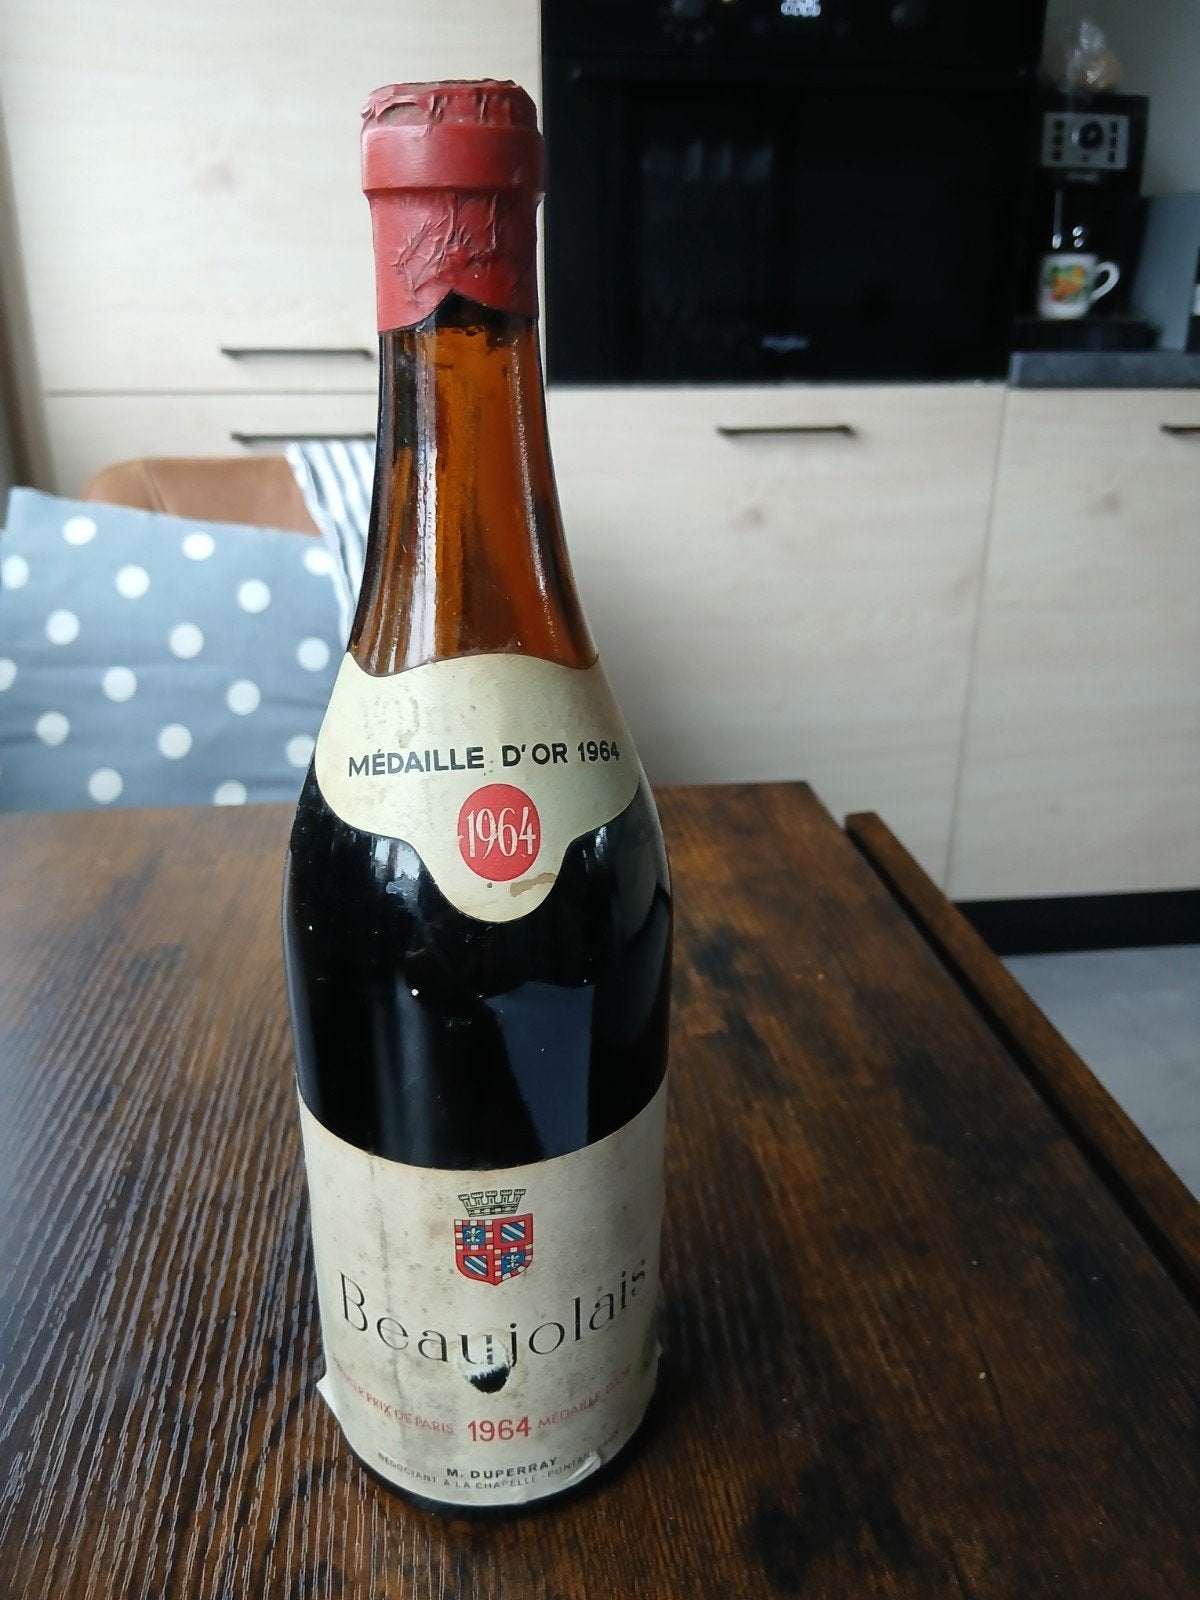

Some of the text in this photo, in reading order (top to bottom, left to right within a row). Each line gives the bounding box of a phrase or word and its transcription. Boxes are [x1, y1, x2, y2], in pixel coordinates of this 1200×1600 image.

[348, 740, 621, 778] MÉDAILLE D'OR 1964
[466, 806, 537, 860] 1964
[338, 1259, 646, 1368] Beaujolais
[366, 1392, 391, 1417] PRIX
[394, 1409, 413, 1425] DE
[415, 1416, 454, 1434] PARIS
[467, 1416, 532, 1442] 1964
[446, 1456, 558, 1479] M. DUPERRAY
[455, 1480, 471, 1489] LA
